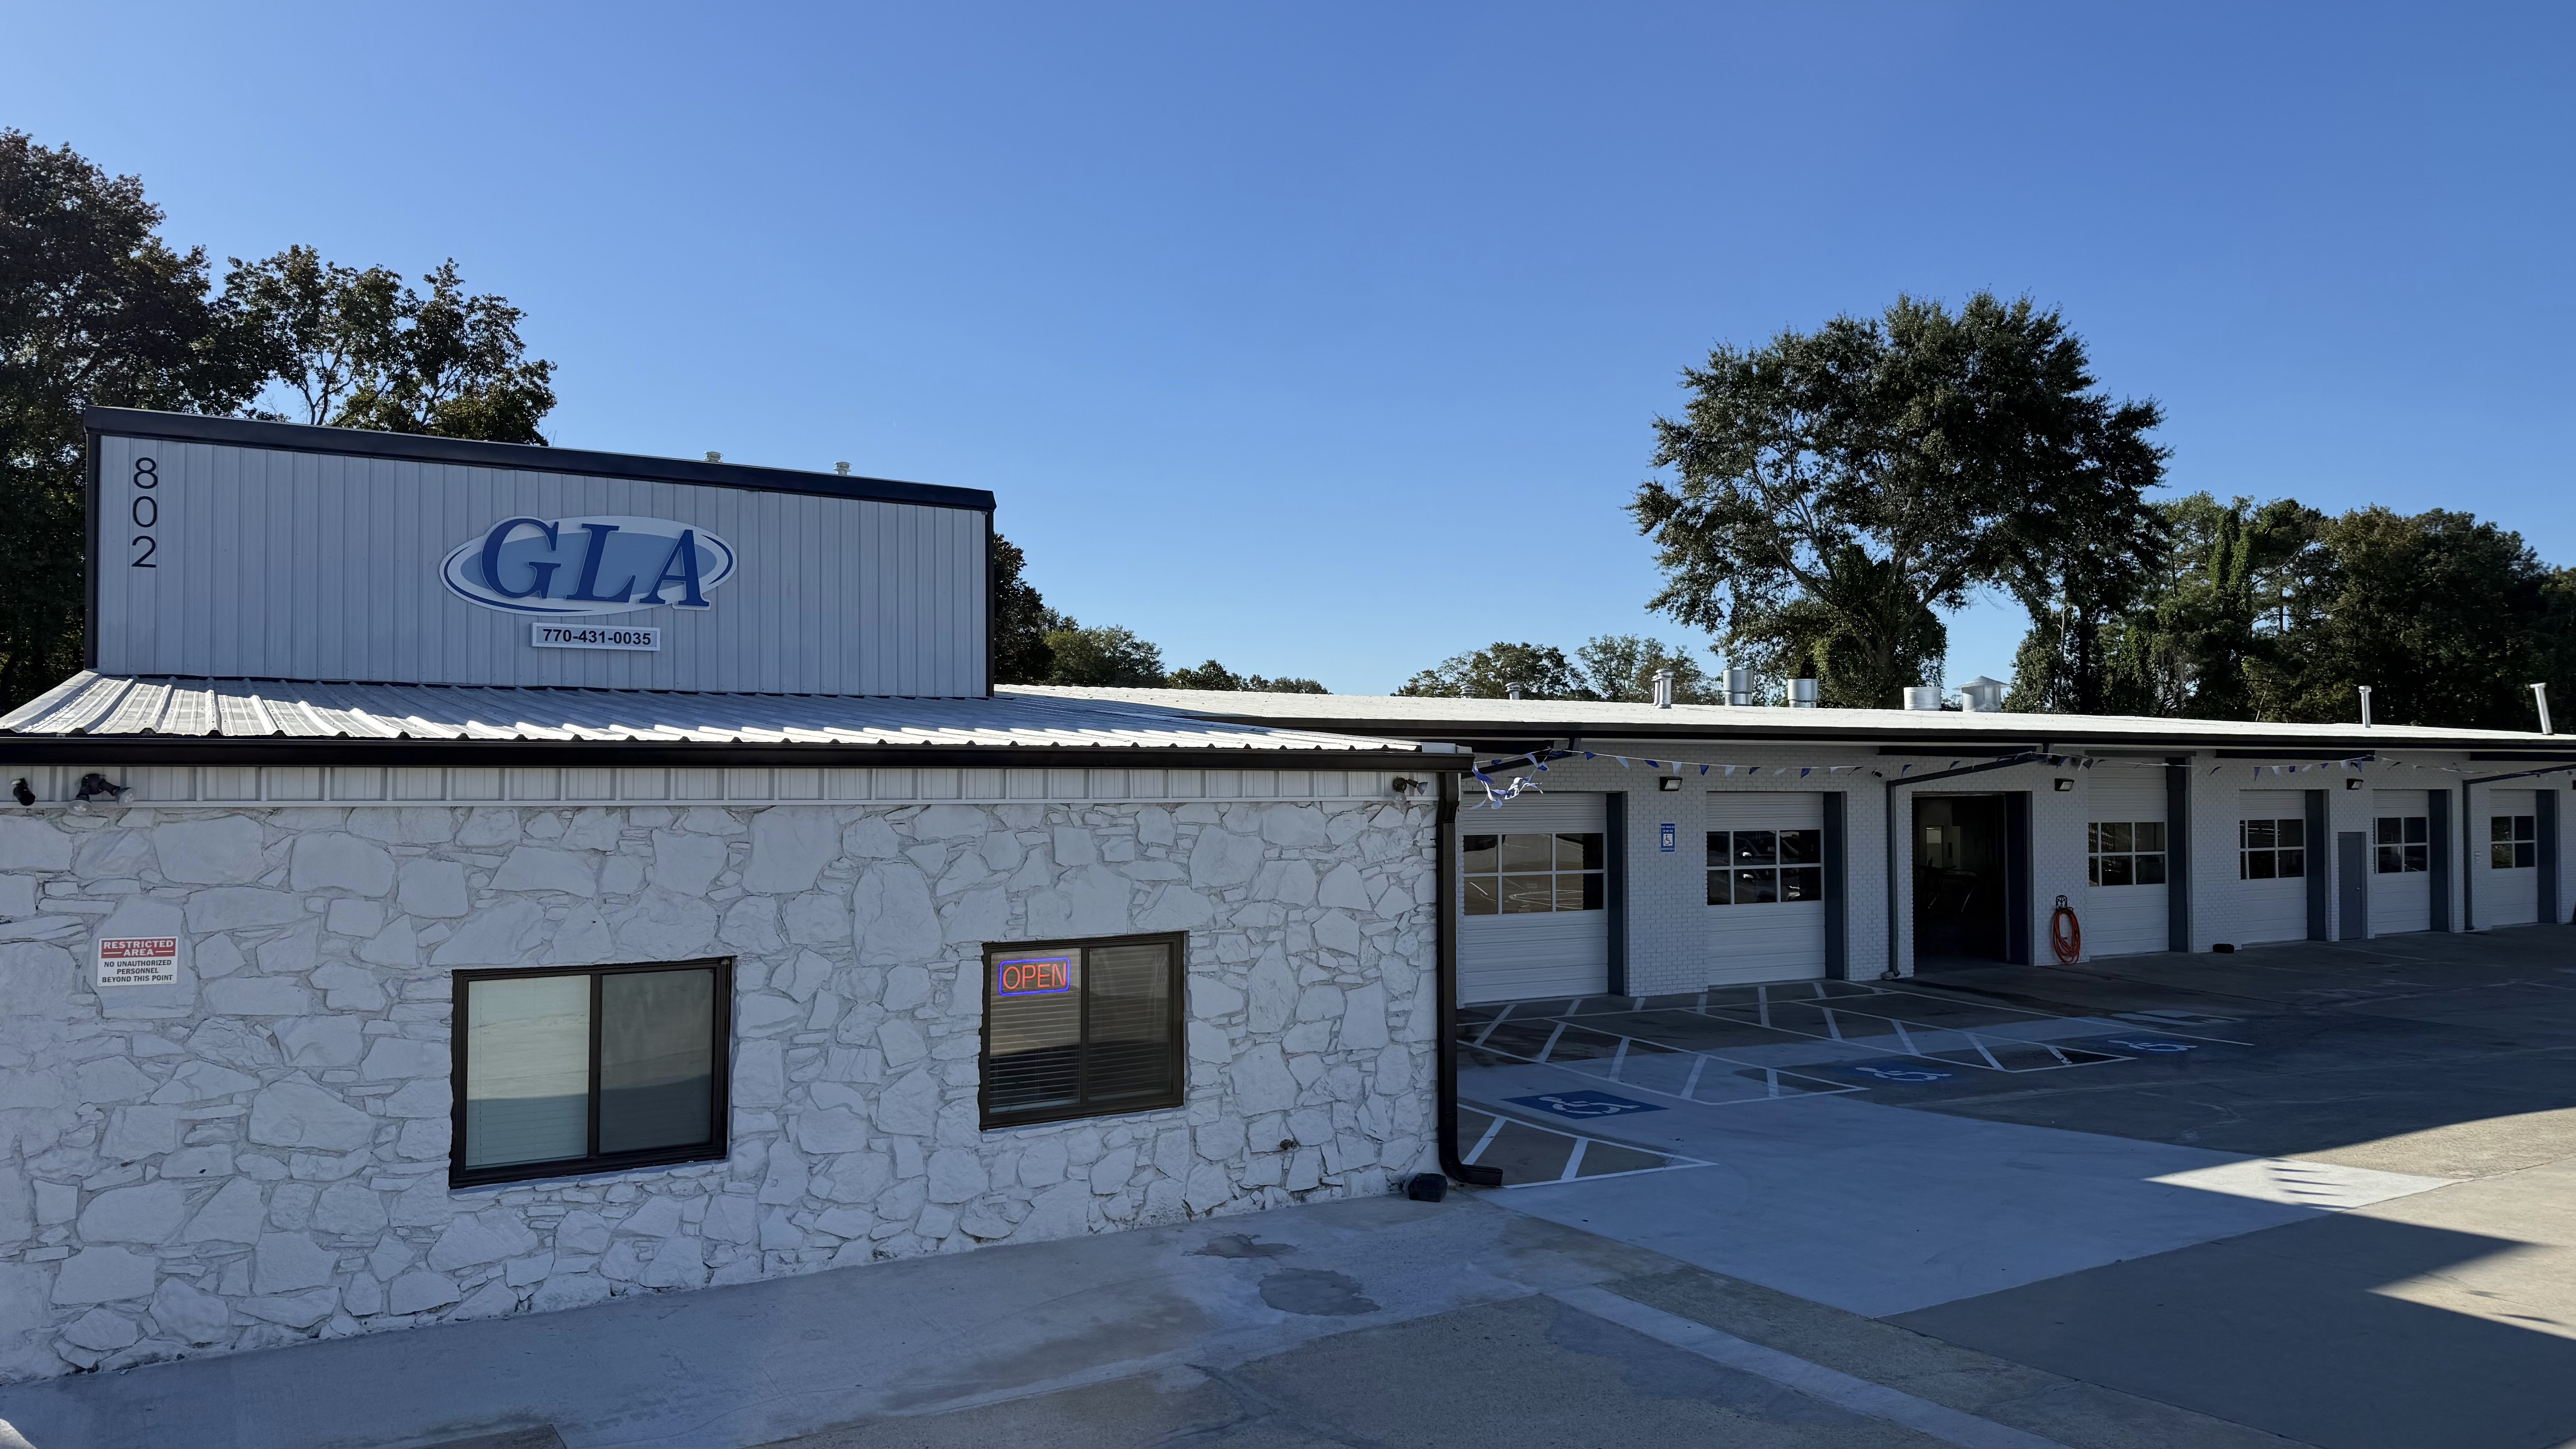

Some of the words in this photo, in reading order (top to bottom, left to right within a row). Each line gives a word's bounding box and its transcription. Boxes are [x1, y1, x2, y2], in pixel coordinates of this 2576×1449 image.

[131, 457, 158, 568] 802
[480, 518, 710, 607] GLA
[543, 629, 651, 645] 770-431-0035
[104, 940, 174, 949] RESTRICTED
[1003, 963, 1066, 989] OPEN
